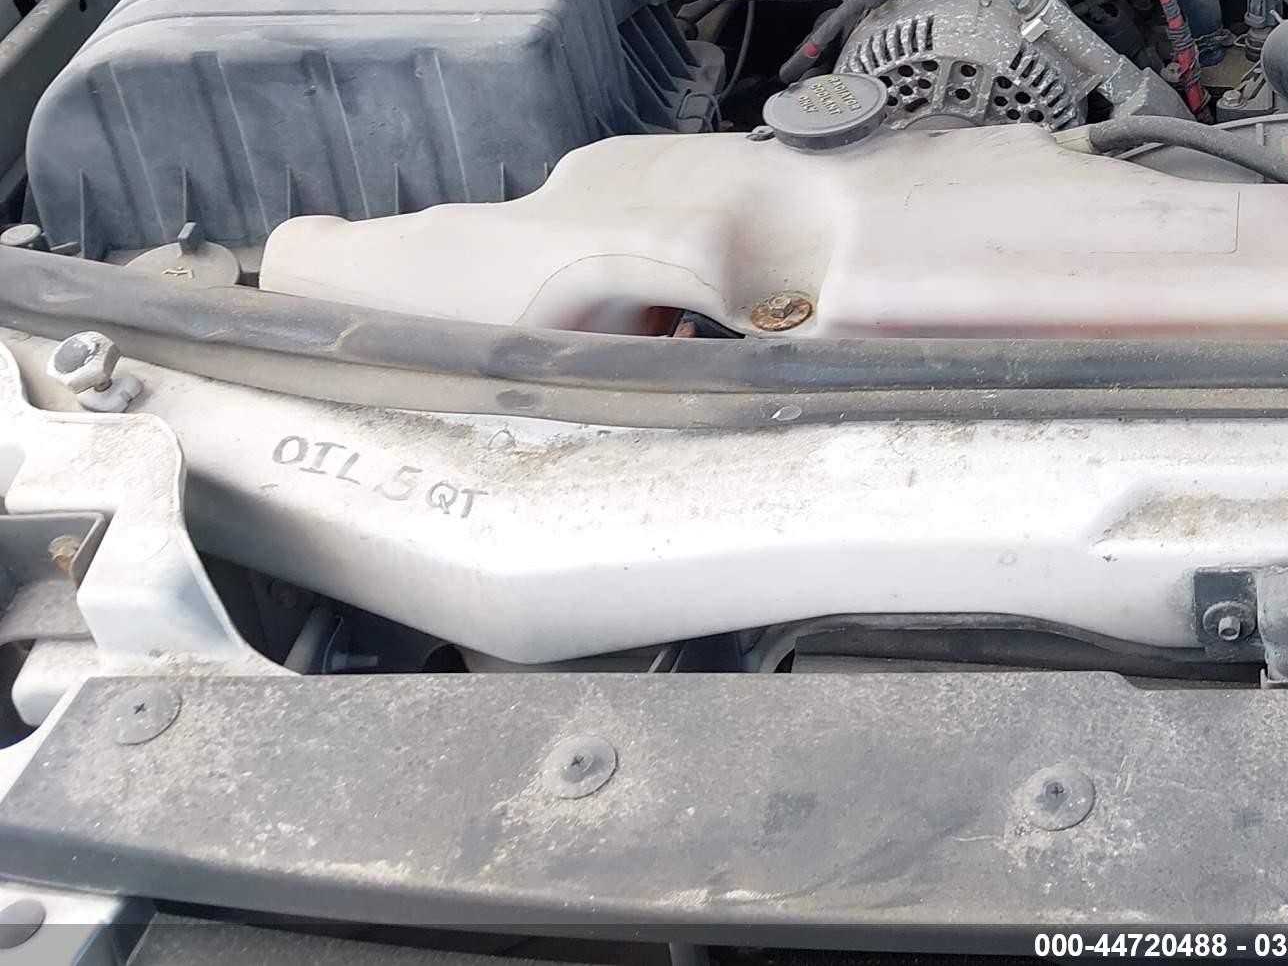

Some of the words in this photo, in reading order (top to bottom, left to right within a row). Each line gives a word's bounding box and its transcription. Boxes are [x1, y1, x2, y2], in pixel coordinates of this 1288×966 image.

[799, 95, 819, 113] ONLY
[810, 83, 843, 115] COOLANT
[826, 76, 862, 111] RADIATOR
[272, 435, 361, 485] OIL
[374, 464, 424, 501] 5
[425, 480, 489, 519] QT
